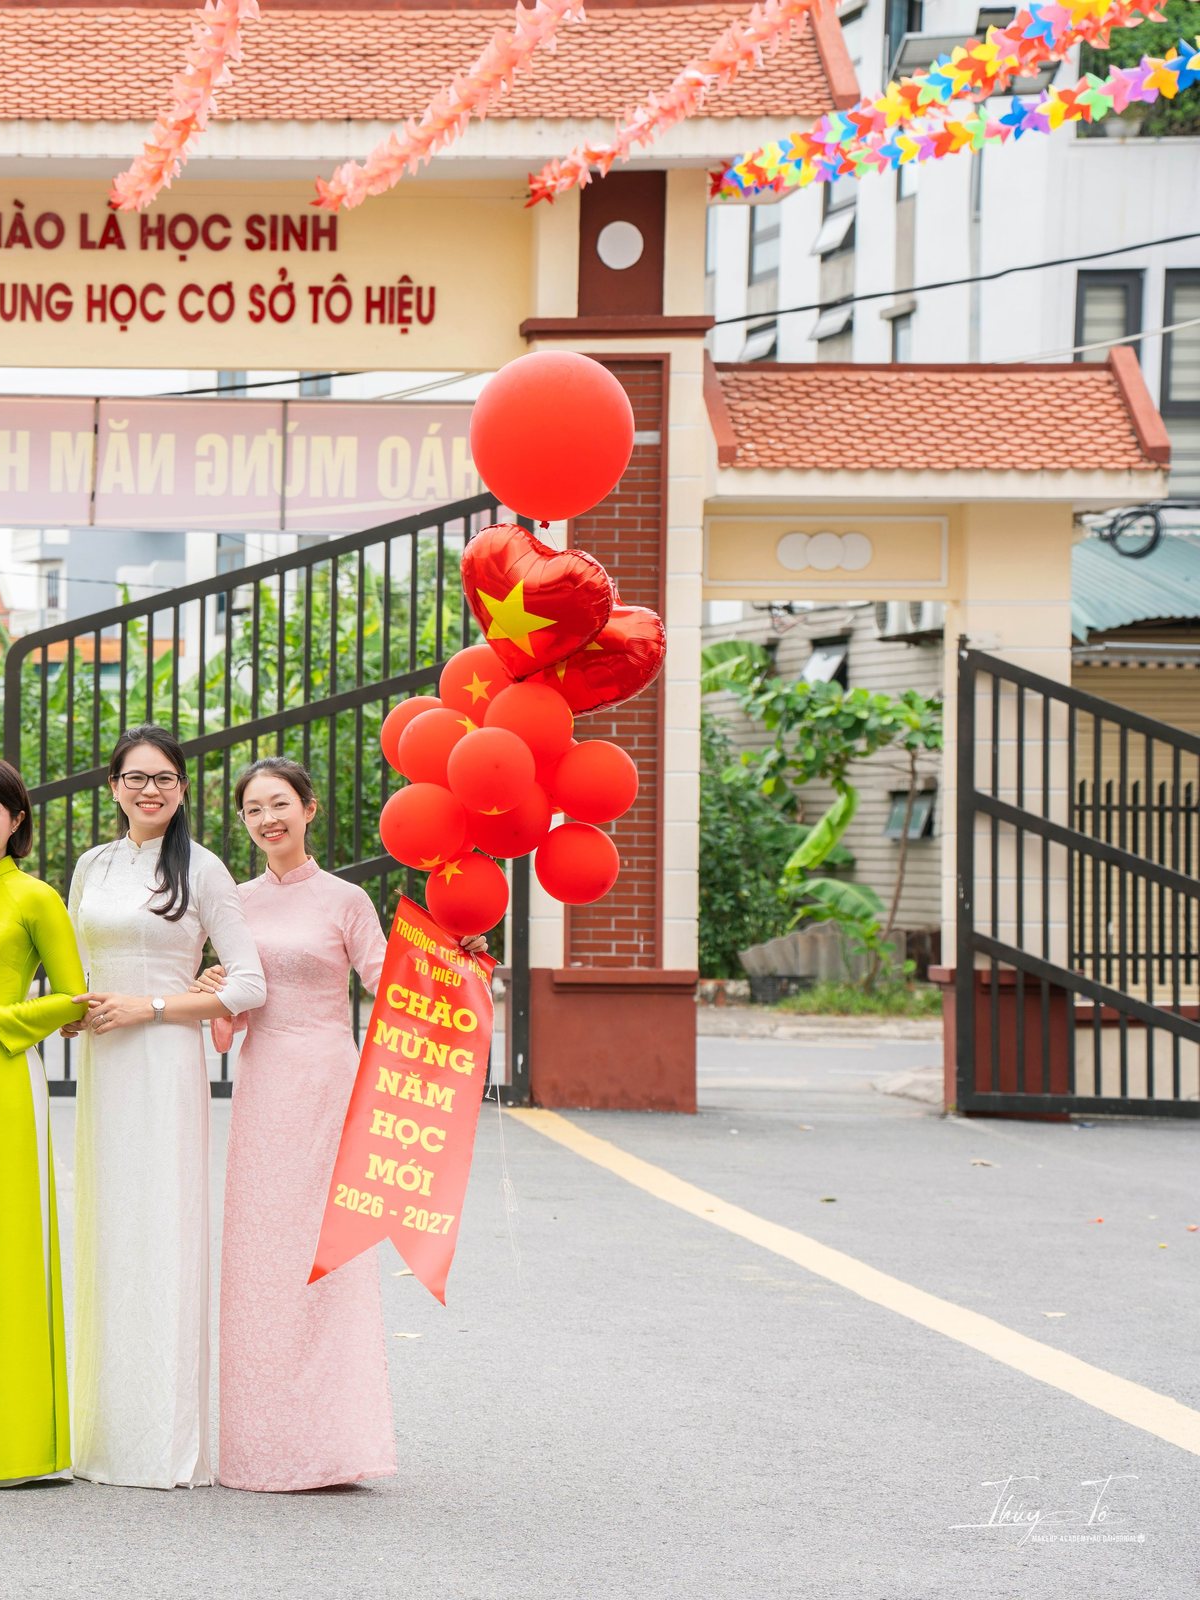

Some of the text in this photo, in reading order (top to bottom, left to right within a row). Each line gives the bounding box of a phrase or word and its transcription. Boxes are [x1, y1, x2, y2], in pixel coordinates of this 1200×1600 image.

[79, 199, 127, 250] LÀ
[139, 213, 232, 263] HỌC
[244, 214, 339, 252] SINH
[86, 283, 166, 332] HỌC
[178, 281, 236, 323] CƠ
[248, 267, 297, 324] SỞ
[308, 273, 353, 324] TÔ
[365, 274, 437, 334] HIỆU
[396, 917, 437, 955] TRƯỜNG
[439, 945, 465, 968] TIỂU
[415, 957, 463, 987] TÔ HIỆU
[386, 983, 478, 1033] CHÀO
[372, 1018, 476, 1077] MỪNG
[375, 1066, 456, 1113] NĂM
[369, 1108, 447, 1153] HỌC
[364, 1153, 435, 1197] MỚI
[333, 1183, 456, 1235] 2026 - 2027
